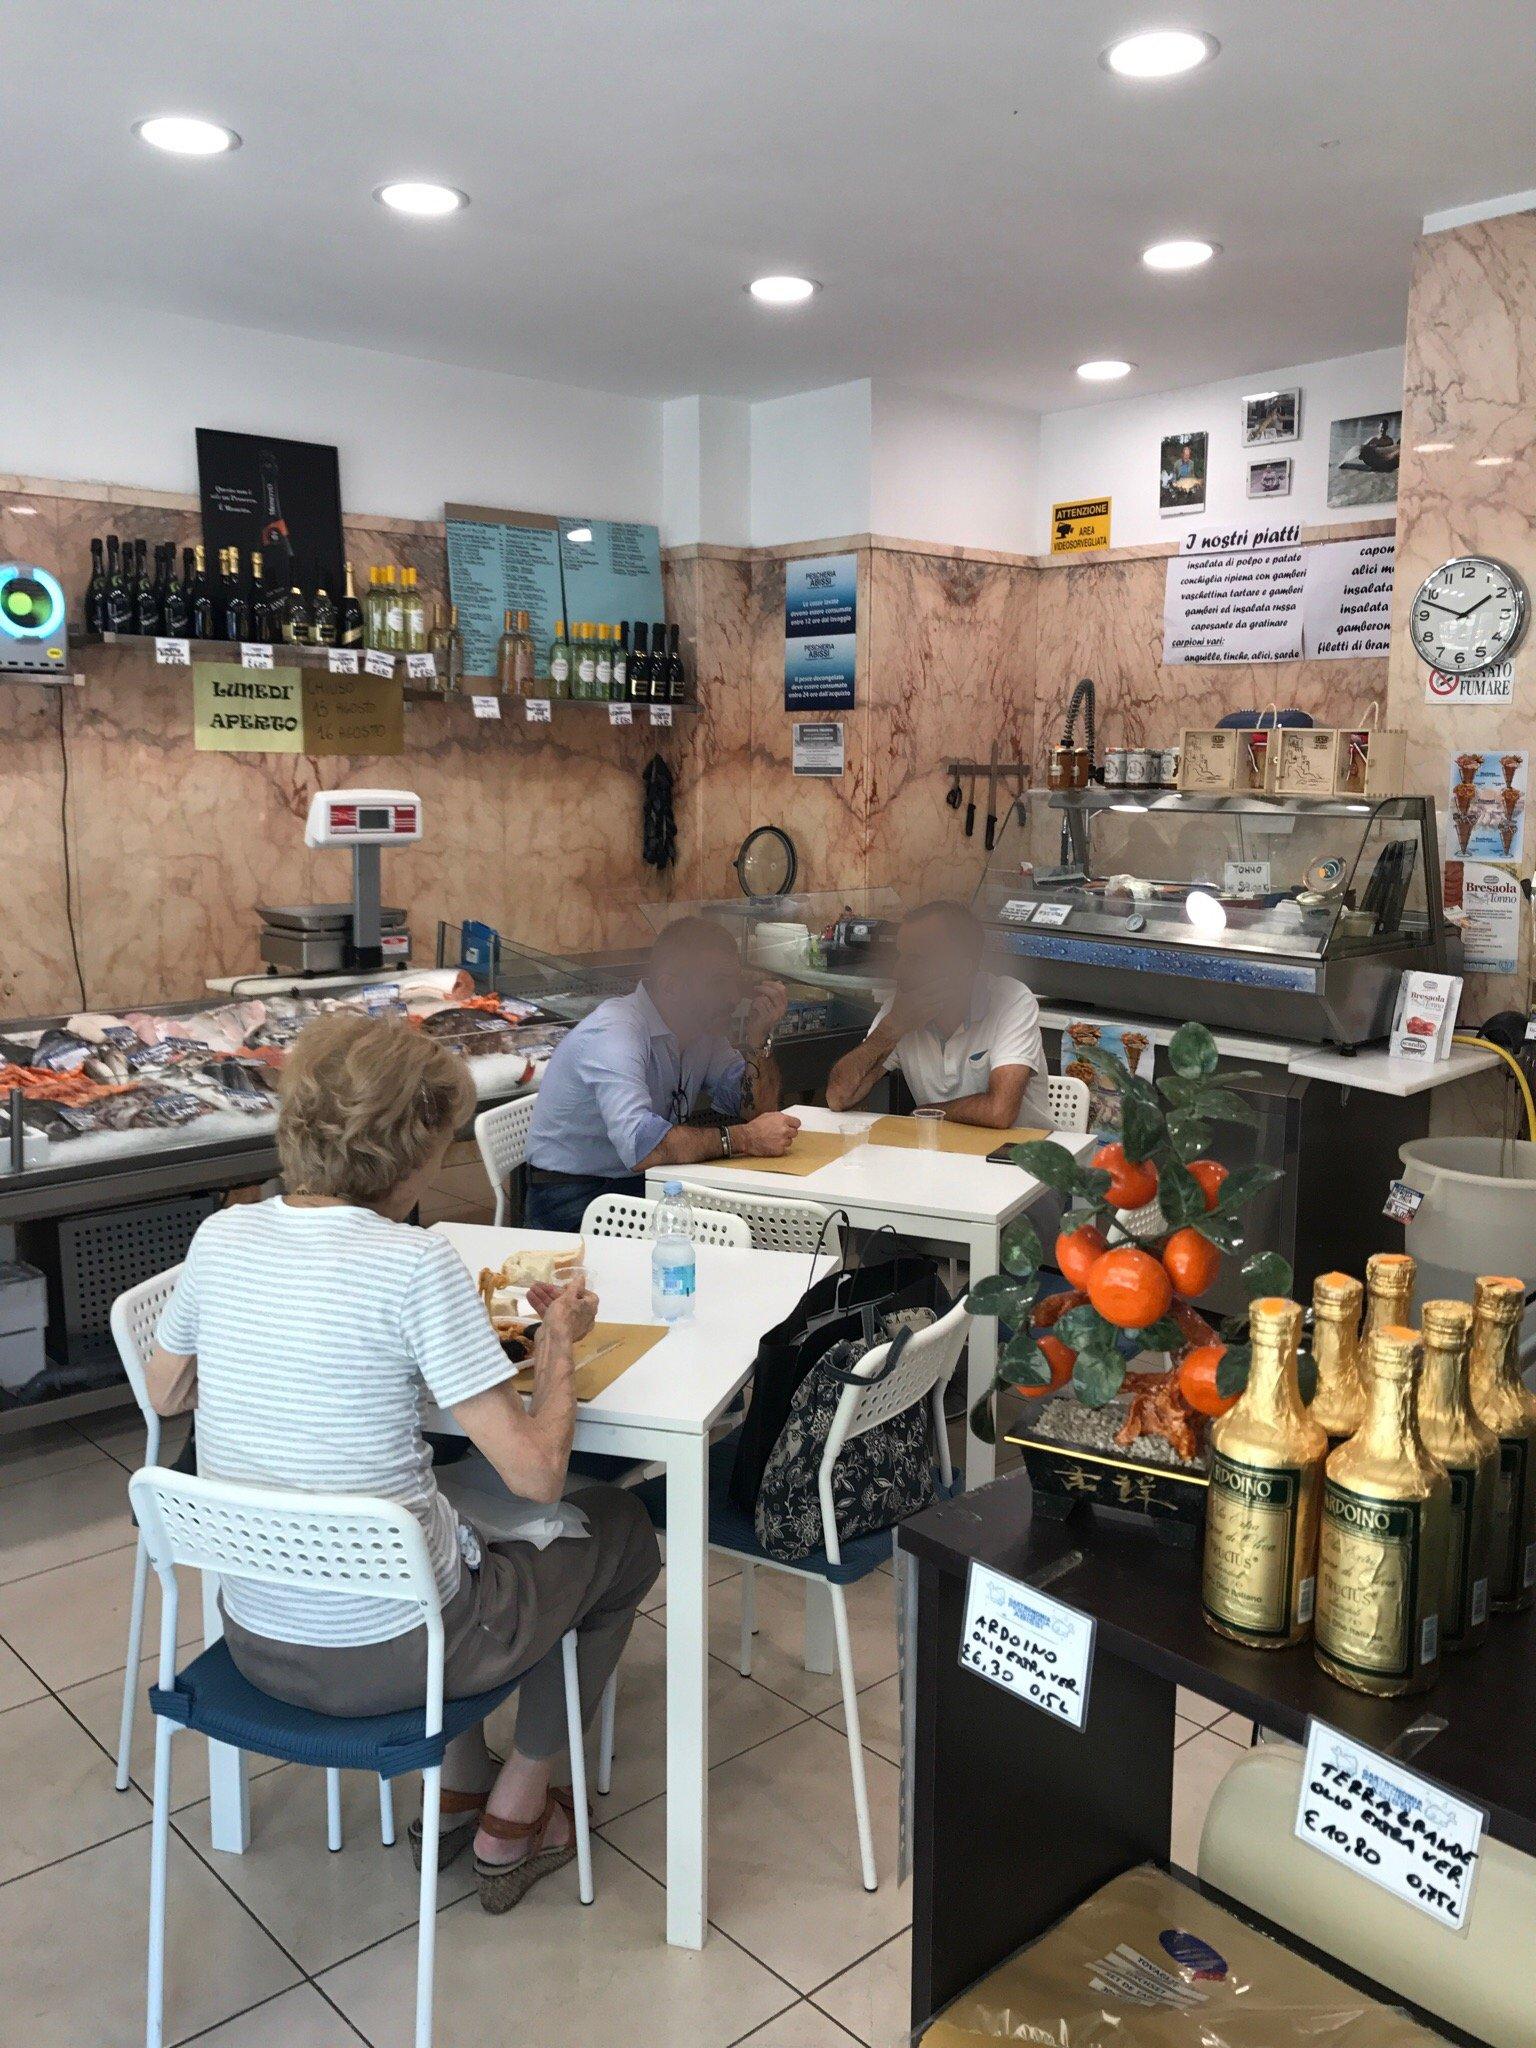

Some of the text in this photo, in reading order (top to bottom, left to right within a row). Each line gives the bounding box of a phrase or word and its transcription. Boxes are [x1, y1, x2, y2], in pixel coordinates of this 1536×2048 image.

[1056, 504, 1107, 519] ATTENZIONE
[1079, 526, 1095, 536] AREA
[1053, 536, 1107, 551] VIDEOSORVEGLIATA
[1186, 525, 1300, 550] I nostri piatti
[1187, 558, 1223, 570] insalata
[1225, 557, 1234, 566] di
[1236, 556, 1263, 568] polpo
[1272, 553, 1302, 565] patate
[1351, 564, 1378, 575] alici
[1461, 567, 1476, 578] 12
[1180, 568, 1307, 586] conchiglia ripiena con gamberi
[1444, 573, 1453, 584] 11
[1181, 590, 1228, 601] vaschettina
[1230, 588, 1260, 598] tartare
[1269, 585, 1304, 598] gamberi
[1343, 582, 1393, 595] insalata
[1428, 589, 1439, 600] 10
[1496, 587, 1508, 598] 2
[1185, 603, 1297, 618] gamberi ed insalata russa
[1340, 601, 1389, 614] insalata
[1419, 610, 1430, 621] 9
[1191, 619, 1288, 631] capesante da gratinare
[1336, 620, 1391, 635] gamberon
[1172, 637, 1205, 648] carpioni
[1422, 631, 1434, 642] 8
[1491, 631, 1502, 642] 4
[1318, 641, 1349, 654] filetti
[1351, 640, 1362, 651] di
[1436, 647, 1446, 658] 7
[1475, 646, 1487, 658] 5
[1274, 648, 1300, 660] sarde
[1454, 652, 1466, 664] 6
[1460, 680, 1510, 696] FUMARE
[210, 713, 298, 731] APERTO
[1466, 882, 1517, 894] Bresaola
[1411, 992, 1445, 1003] Bresaola
[972, 1631, 1003, 1655] OLIO
[975, 1615, 1057, 1664] ARDOINO
[1310, 1781, 1352, 1810] OLIO
[1361, 1809, 1415, 1853] EXTRA
